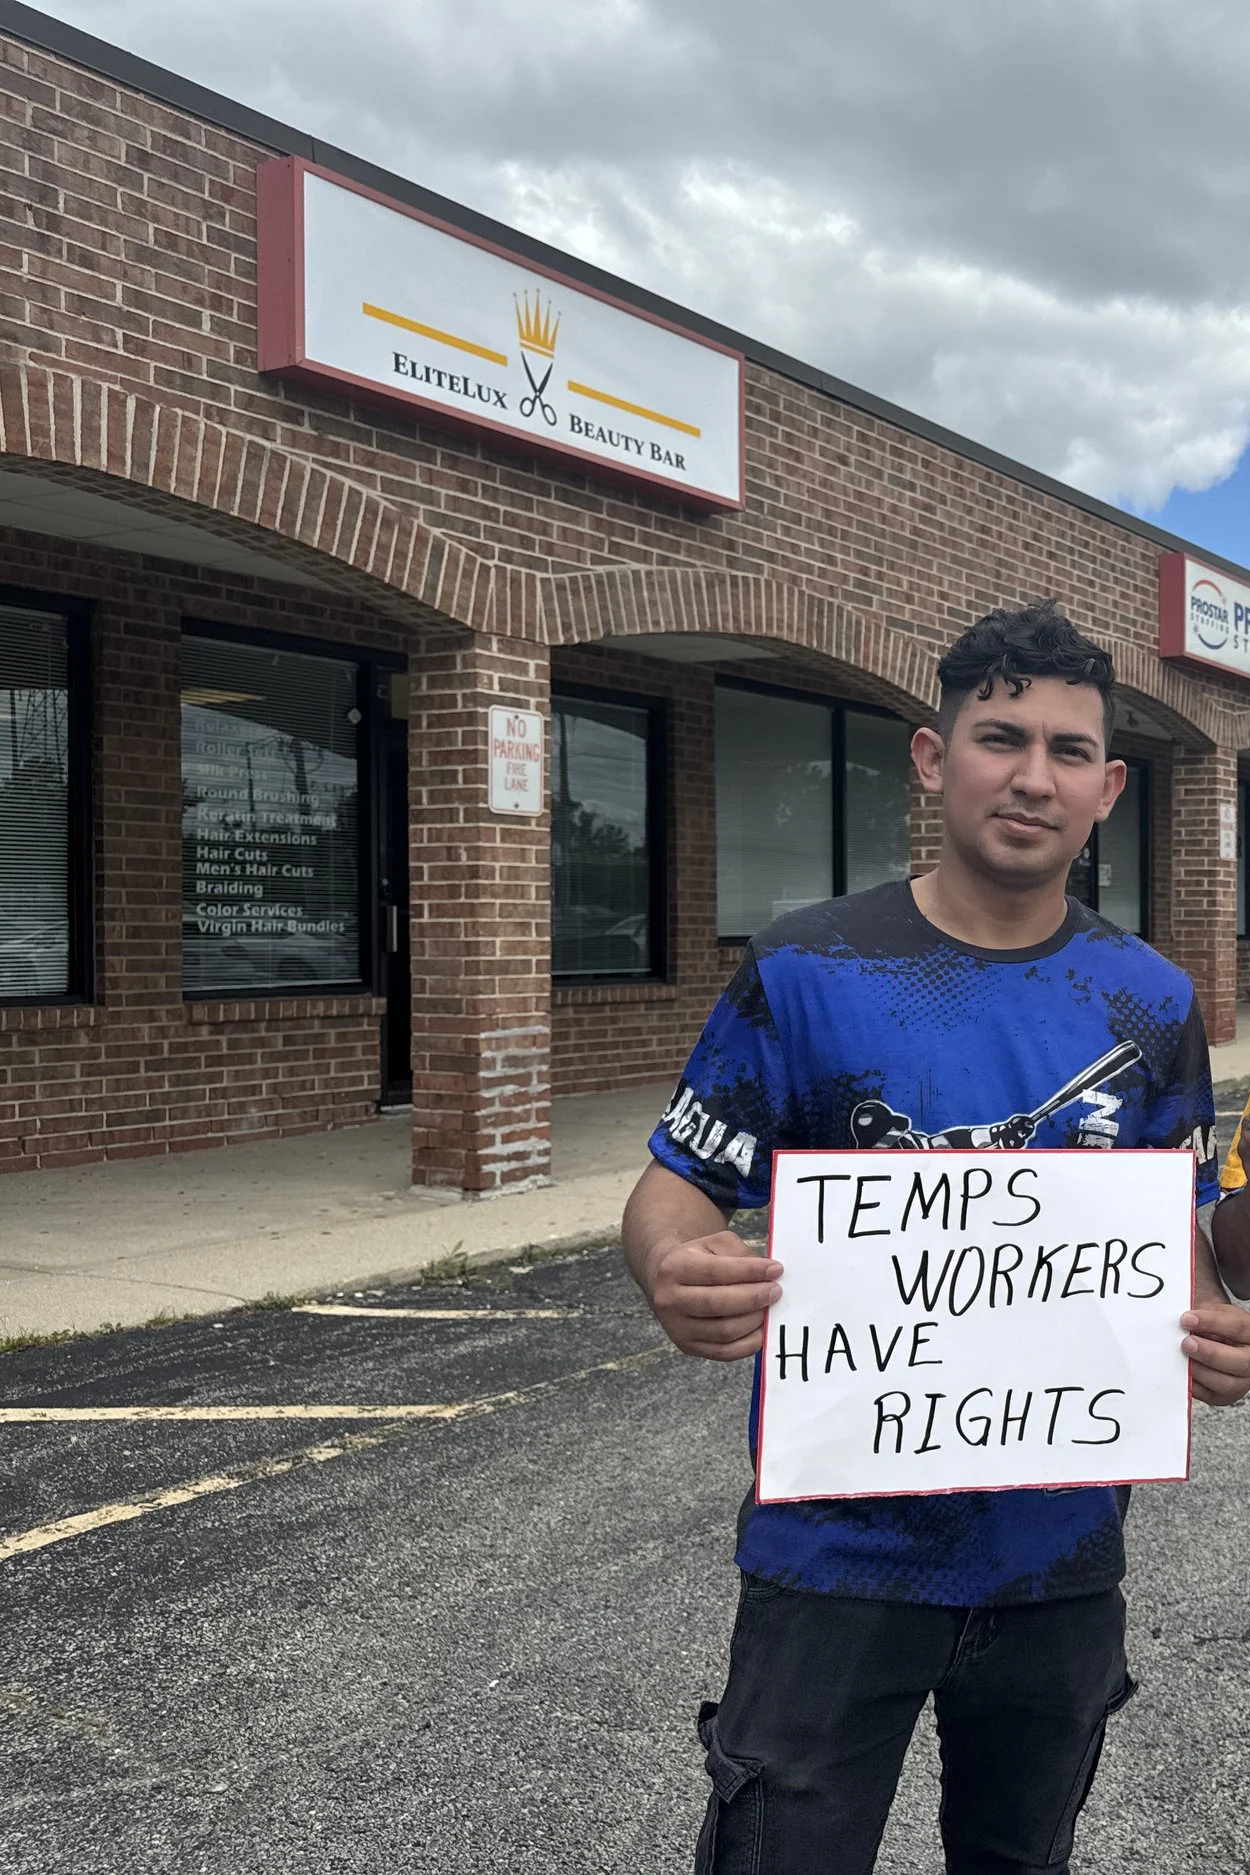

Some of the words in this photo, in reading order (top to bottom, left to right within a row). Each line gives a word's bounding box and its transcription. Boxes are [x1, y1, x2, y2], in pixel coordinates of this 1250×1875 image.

[1190, 596, 1229, 624] PROSTAR
[506, 718, 527, 738] NO
[493, 738, 541, 763] PARKING
[506, 761, 528, 776] FIRE
[504, 778, 529, 792] LANE
[196, 784, 248, 801] Round
[253, 787, 321, 808] Brushing
[197, 829, 231, 842] Hair
[234, 830, 318, 846] Extensions
[196, 846, 232, 860] Hair
[234, 848, 269, 862] Cuts
[195, 862, 242, 876] Men's
[245, 863, 279, 877] Hair
[281, 865, 315, 878] Cuts
[195, 880, 265, 899] Braiding
[195, 902, 239, 917] Color
[242, 902, 304, 918] Services
[197, 918, 248, 937] Virgin
[251, 919, 284, 933] Hair
[286, 919, 345, 934] Bundles
[796, 1168, 1042, 1244] TEMPS
[891, 1238, 1166, 1316] WORKERS
[775, 1321, 943, 1382] HAVE
[873, 1387, 1126, 1455] RIGHTS
